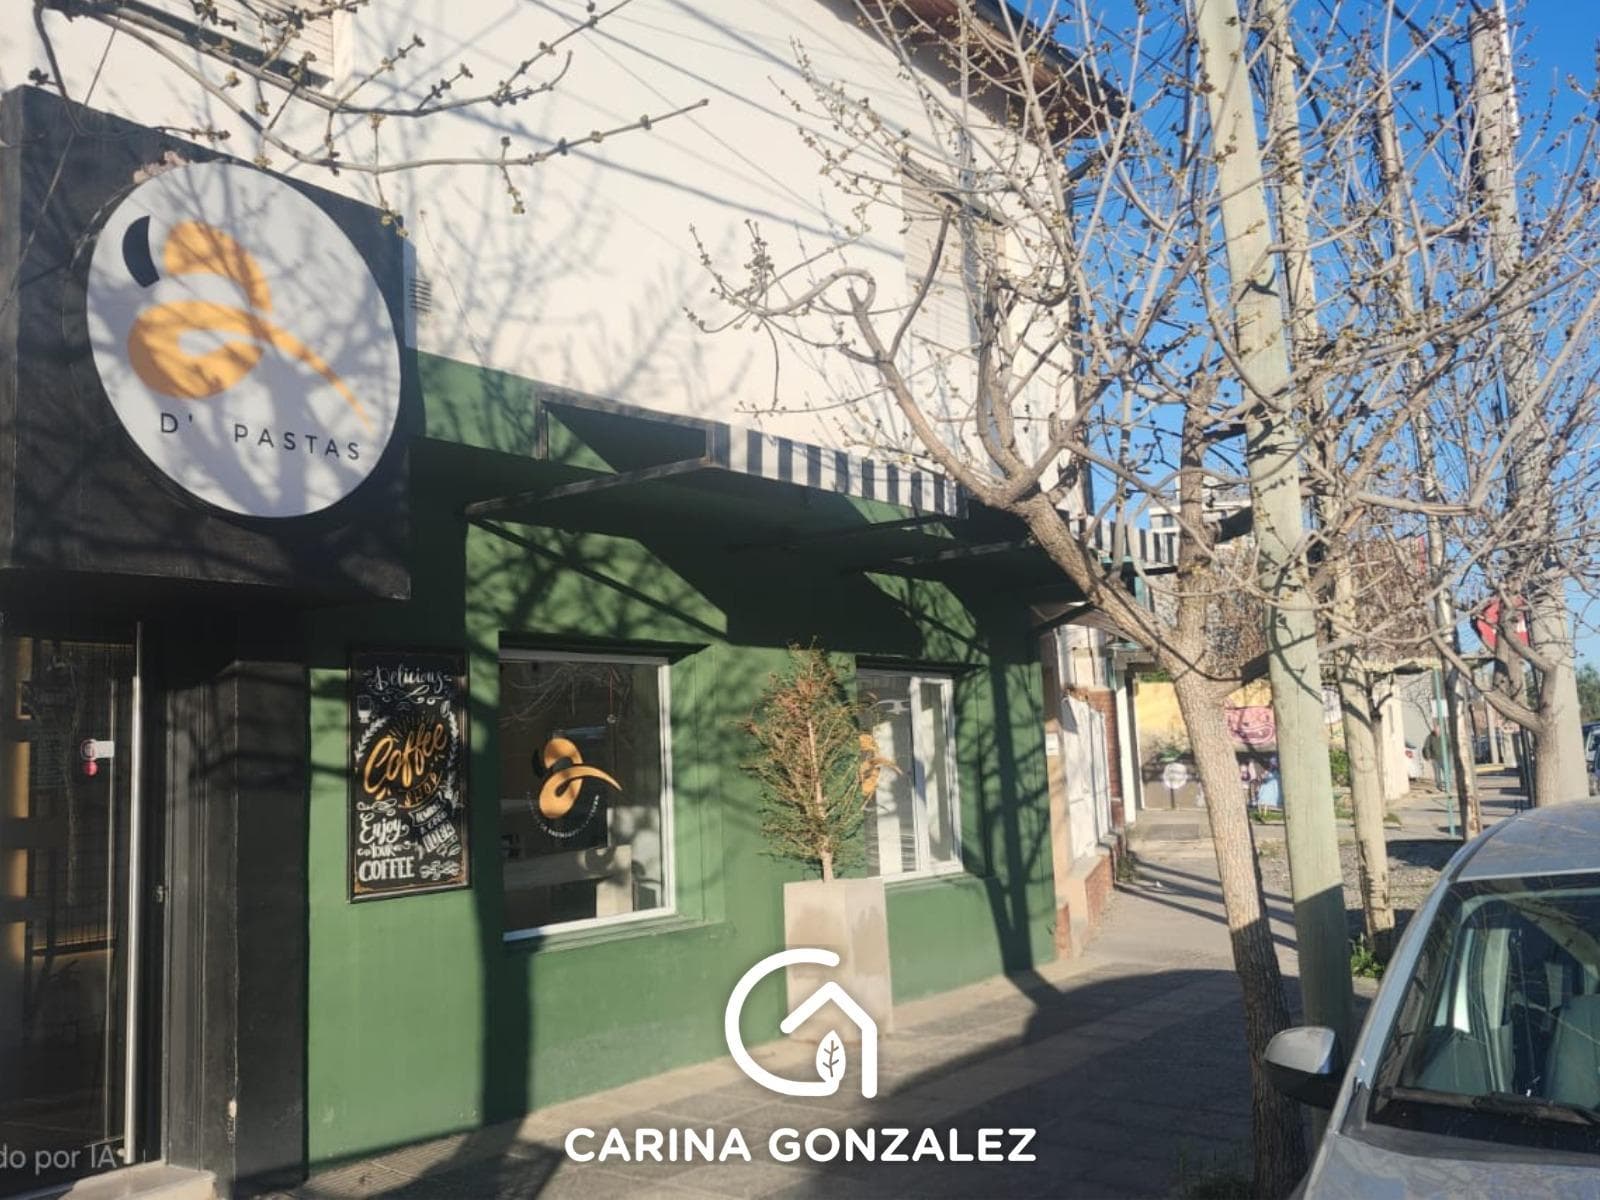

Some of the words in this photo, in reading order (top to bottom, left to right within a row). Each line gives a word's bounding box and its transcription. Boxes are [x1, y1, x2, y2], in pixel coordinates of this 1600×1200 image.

[160, 412, 194, 434] D'
[234, 423, 361, 461] PASTAS
[364, 723, 448, 794] Coffee
[359, 812, 403, 845] Enjoy
[359, 856, 416, 882] COFFEE
